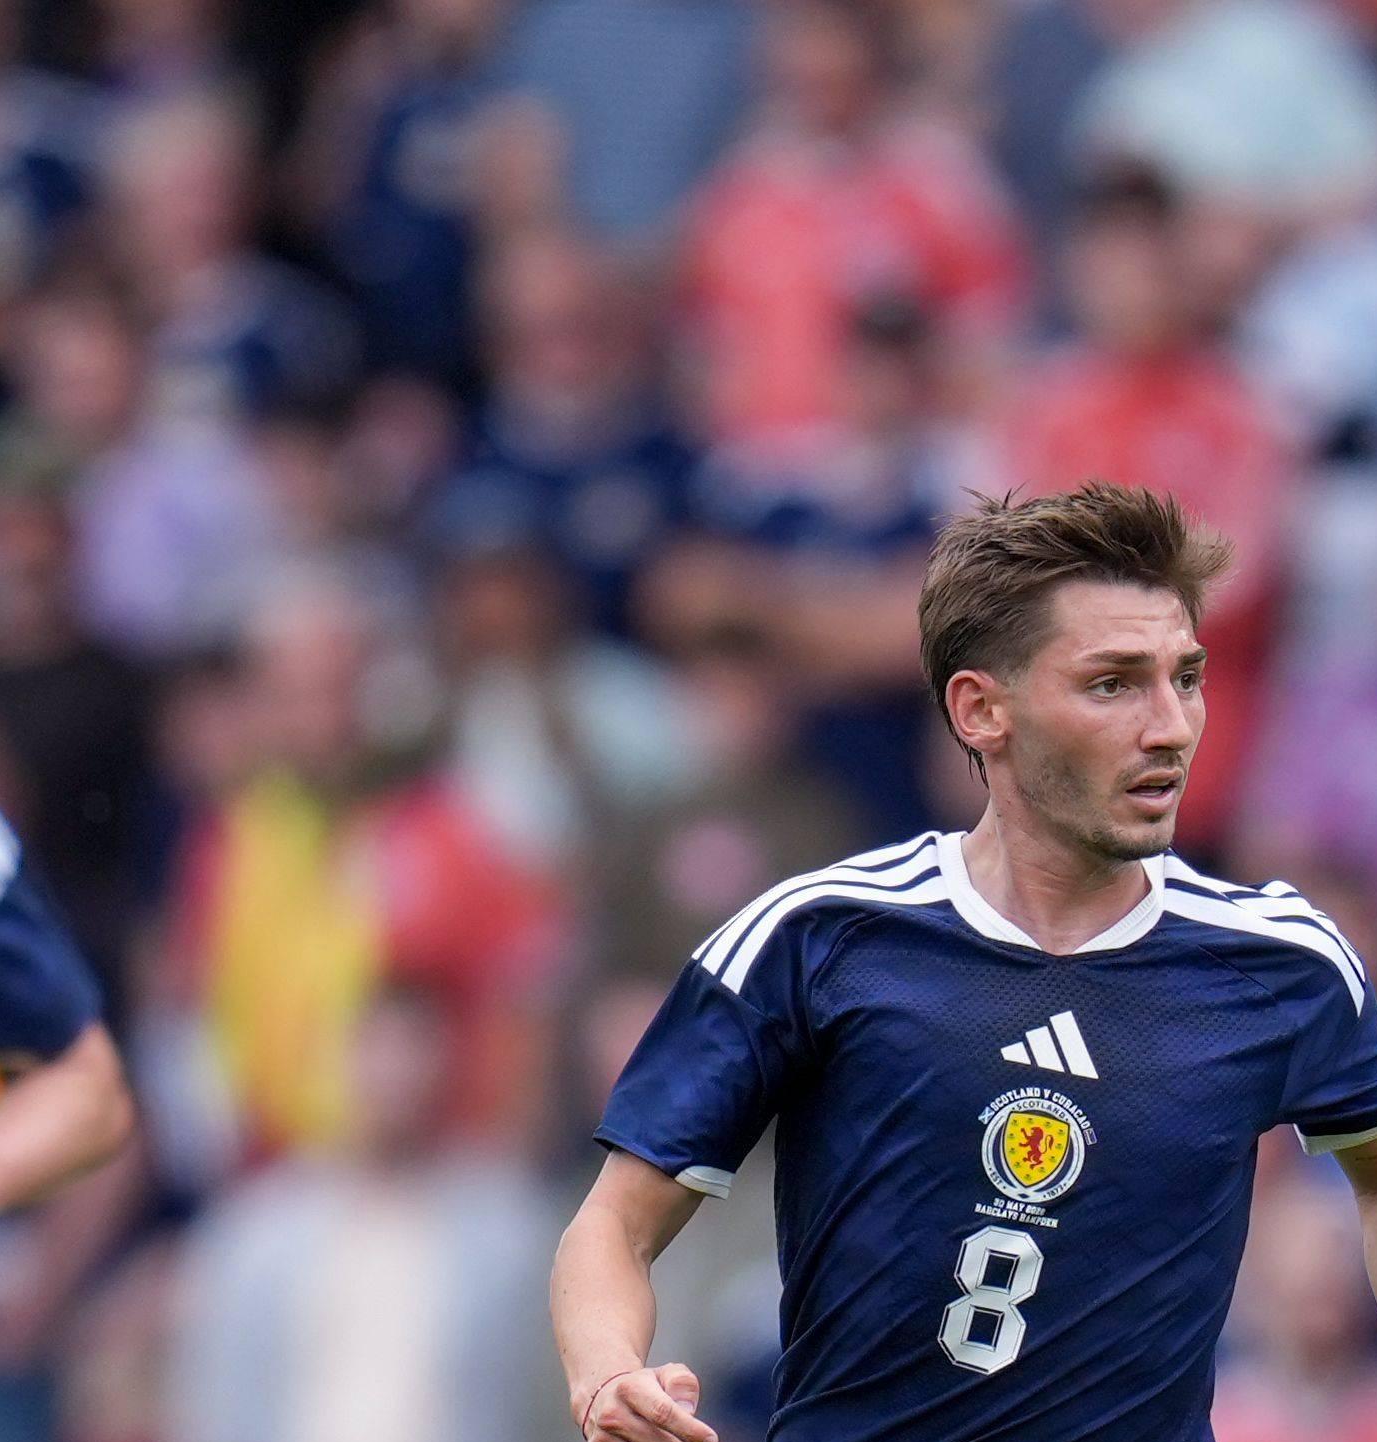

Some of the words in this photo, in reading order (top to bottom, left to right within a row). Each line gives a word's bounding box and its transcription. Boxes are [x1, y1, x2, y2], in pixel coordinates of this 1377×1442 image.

[990, 1087, 1041, 1112] SCOTLAND
[1017, 1101, 1066, 1120] SCOTLAND
[974, 1203, 1019, 1221] BARCLAYS
[1006, 1200, 1025, 1212] MAY
[937, 1225, 1043, 1375] 8
